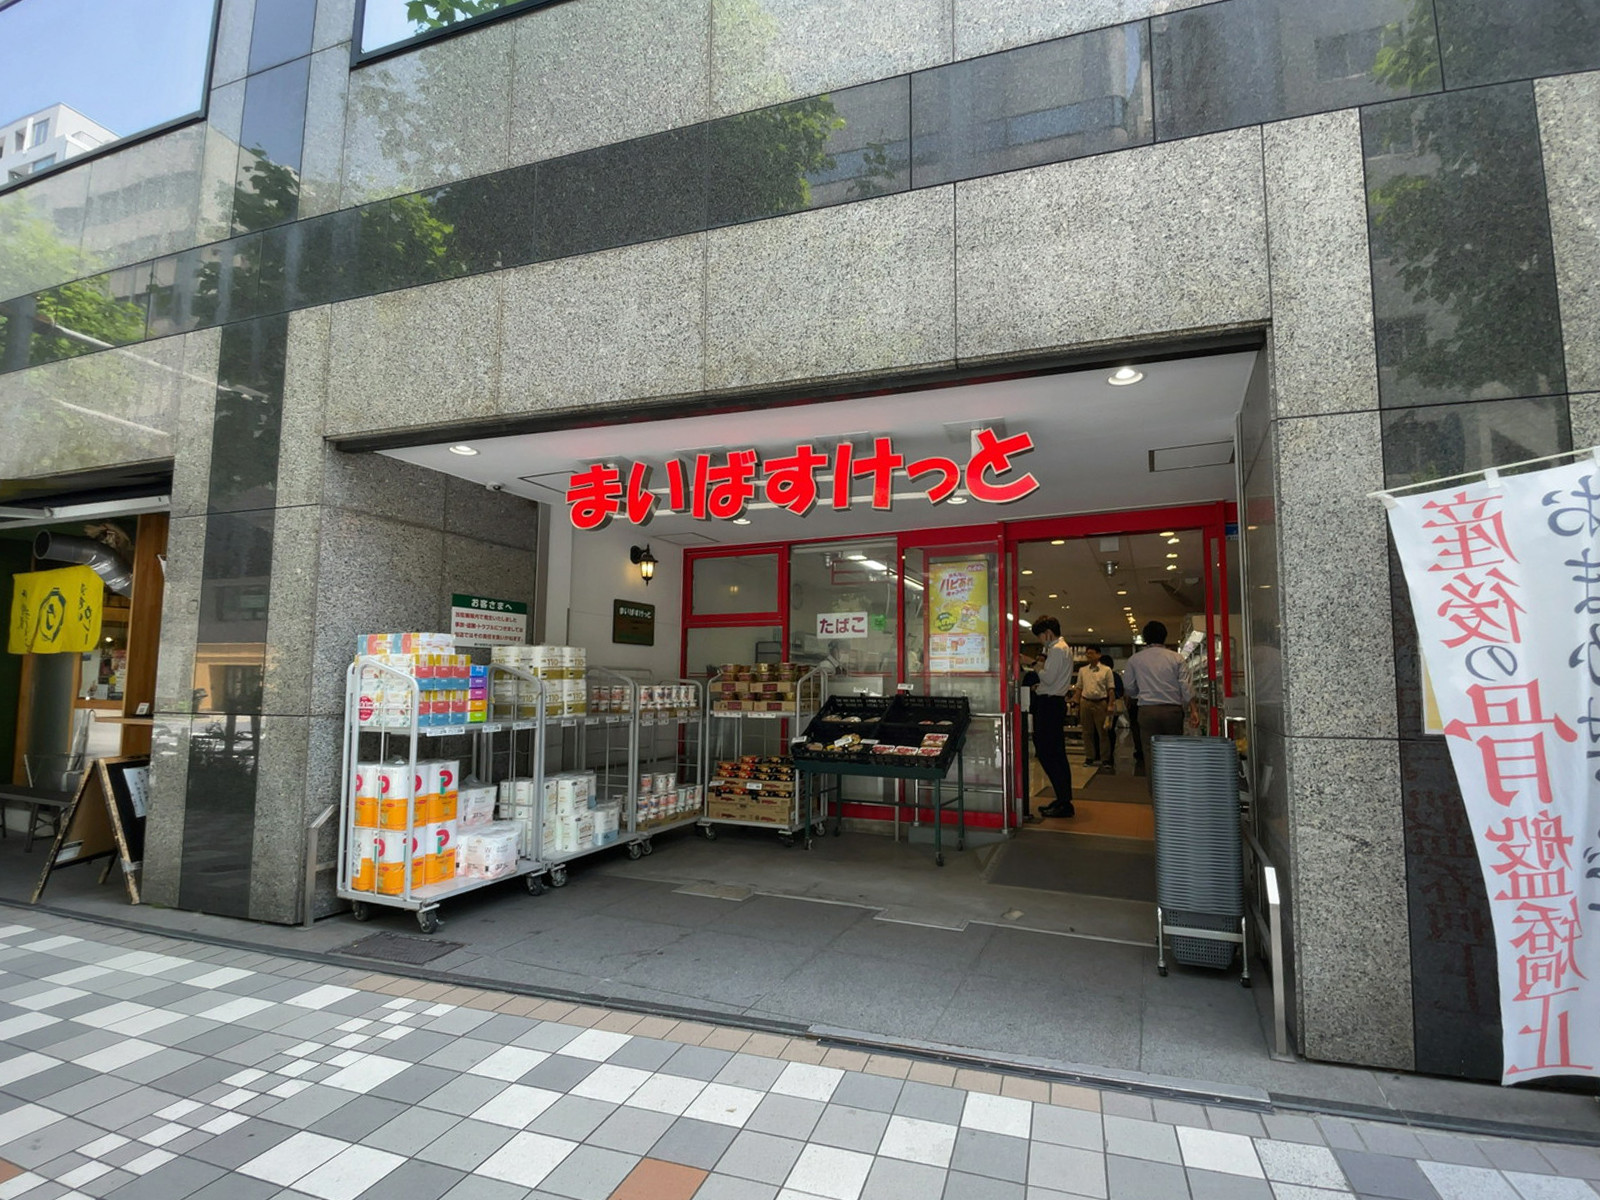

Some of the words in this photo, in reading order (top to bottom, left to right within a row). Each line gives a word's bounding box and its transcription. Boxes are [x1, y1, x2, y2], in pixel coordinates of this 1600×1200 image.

[565, 427, 1040, 530] まいばすけっと
[471, 598, 513, 610] お客さまへ
[819, 616, 865, 634] たばこ
